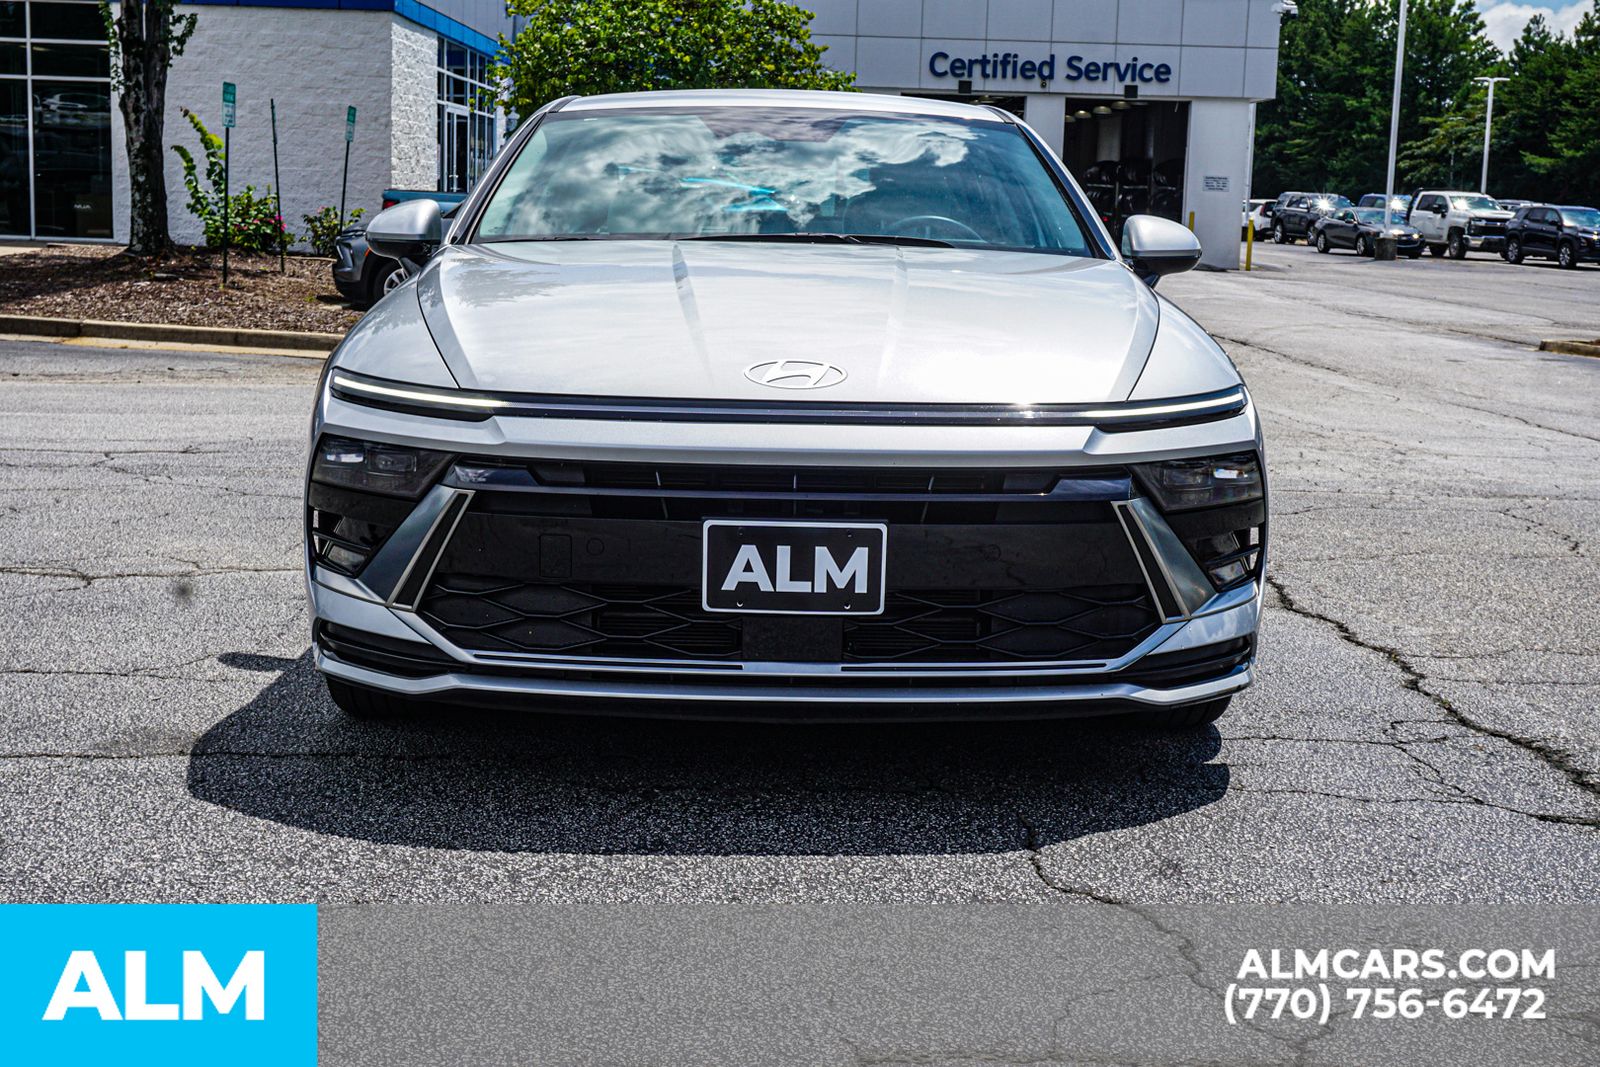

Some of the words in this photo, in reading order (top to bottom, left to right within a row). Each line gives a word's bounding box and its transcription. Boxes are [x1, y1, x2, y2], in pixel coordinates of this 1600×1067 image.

[928, 51, 1056, 81] Certified
[1065, 55, 1172, 83] Service
[721, 544, 869, 594] ALM
